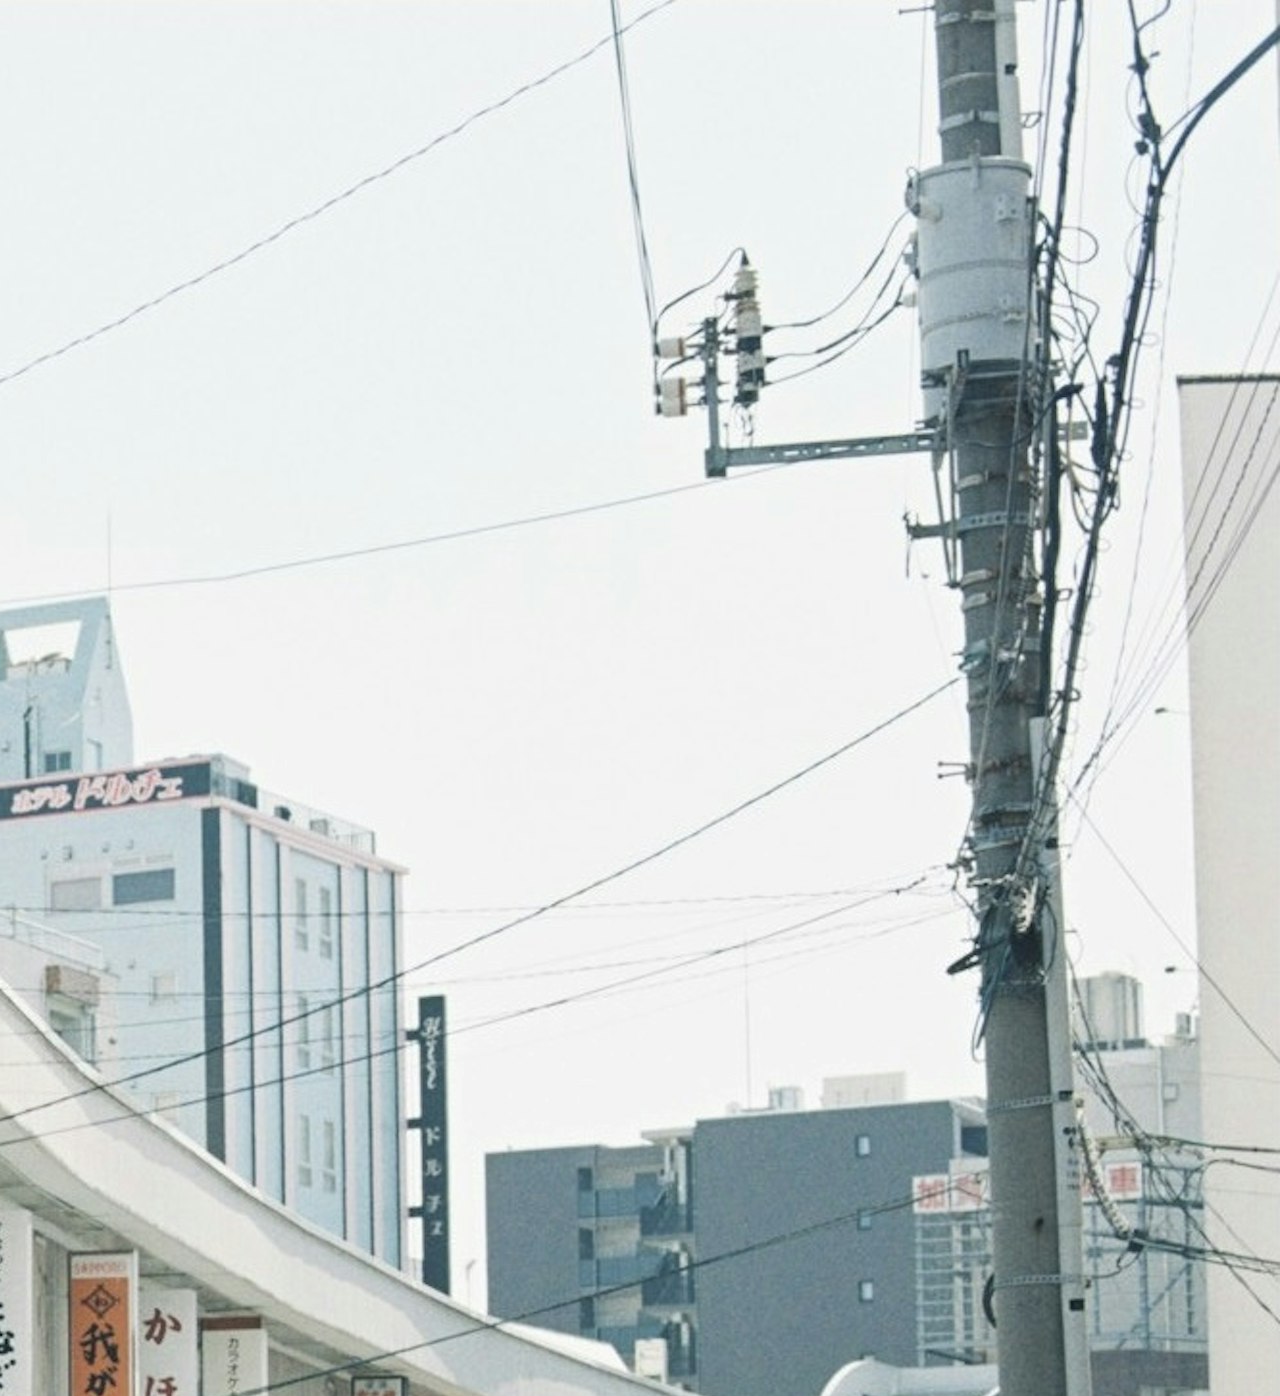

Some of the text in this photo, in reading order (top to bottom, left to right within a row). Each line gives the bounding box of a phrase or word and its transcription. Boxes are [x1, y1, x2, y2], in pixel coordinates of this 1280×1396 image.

[11, 769, 183, 814] ホテル ドルチェ
